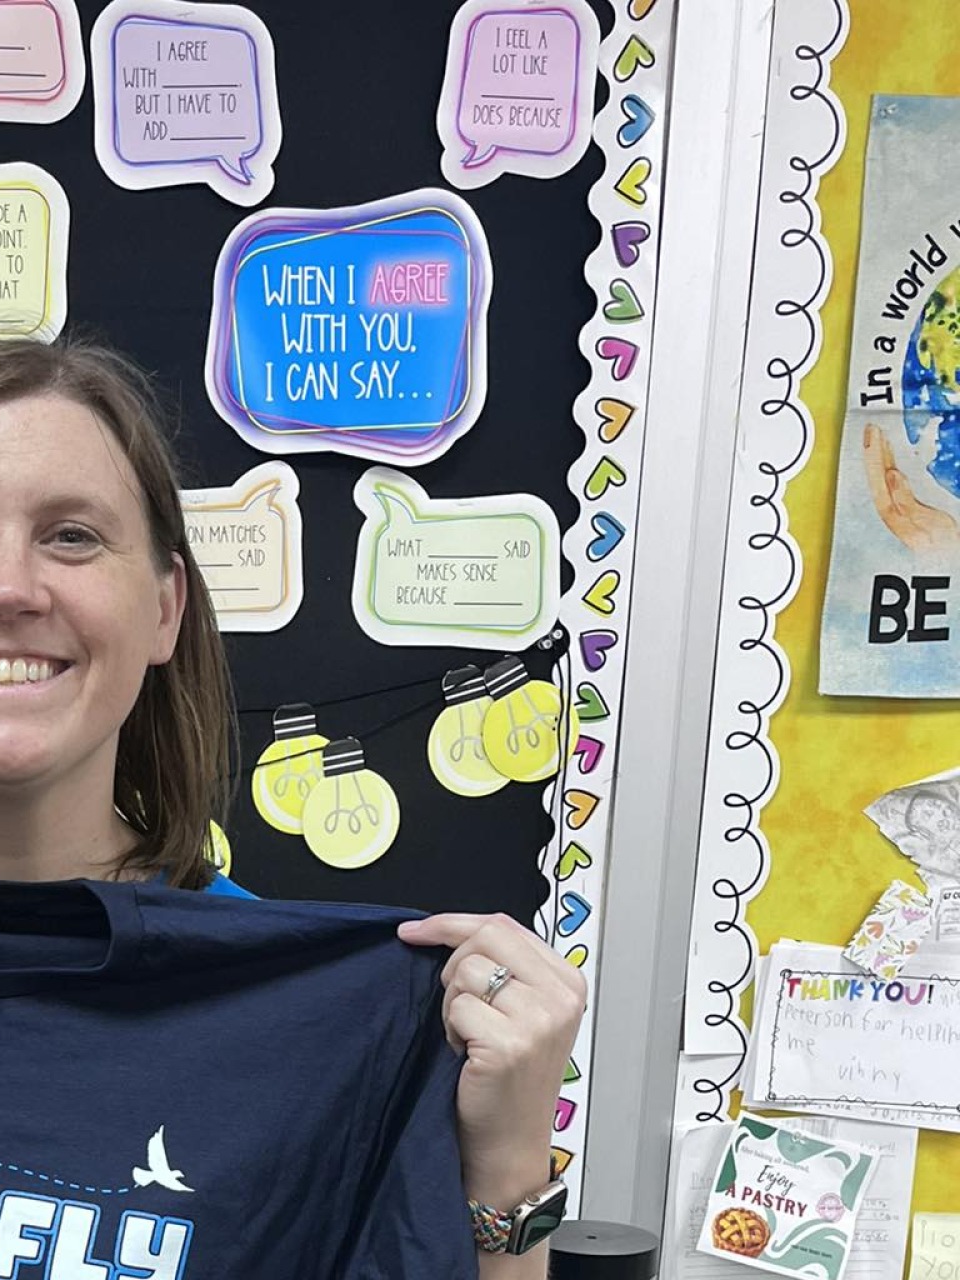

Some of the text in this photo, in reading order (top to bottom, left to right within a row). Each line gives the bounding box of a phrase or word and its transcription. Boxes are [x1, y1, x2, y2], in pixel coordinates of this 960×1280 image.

[496, 28, 548, 49] I FEEL A
[157, 41, 208, 61] I AGREE
[493, 54, 548, 76] LOT LIKE
[123, 68, 157, 88] WITH
[135, 94, 237, 115] BUT I HAVE TO
[473, 105, 563, 128] DOES BECAUSE
[143, 121, 168, 141] ADD
[18, 204, 27, 223] A
[6, 255, 24, 274] TO
[262, 263, 450, 306] WHEN I AGREE
[860, 233, 948, 407] In a world
[281, 312, 346, 354] WITH
[265, 360, 432, 402] I CAN SAY...
[210, 525, 266, 543] MATCHES
[239, 549, 266, 566] SAID
[387, 538, 531, 558] WHAT SAID
[417, 563, 498, 582] MAKES SENSE
[397, 586, 447, 605] BECAUSE
[868, 574, 951, 644] BE
[787, 978, 934, 1005] THANK YOU!
[788, 1033, 816, 1056] me
[757, 1164, 797, 1194] Enjoy
[725, 1182, 808, 1217] A PASTRY
